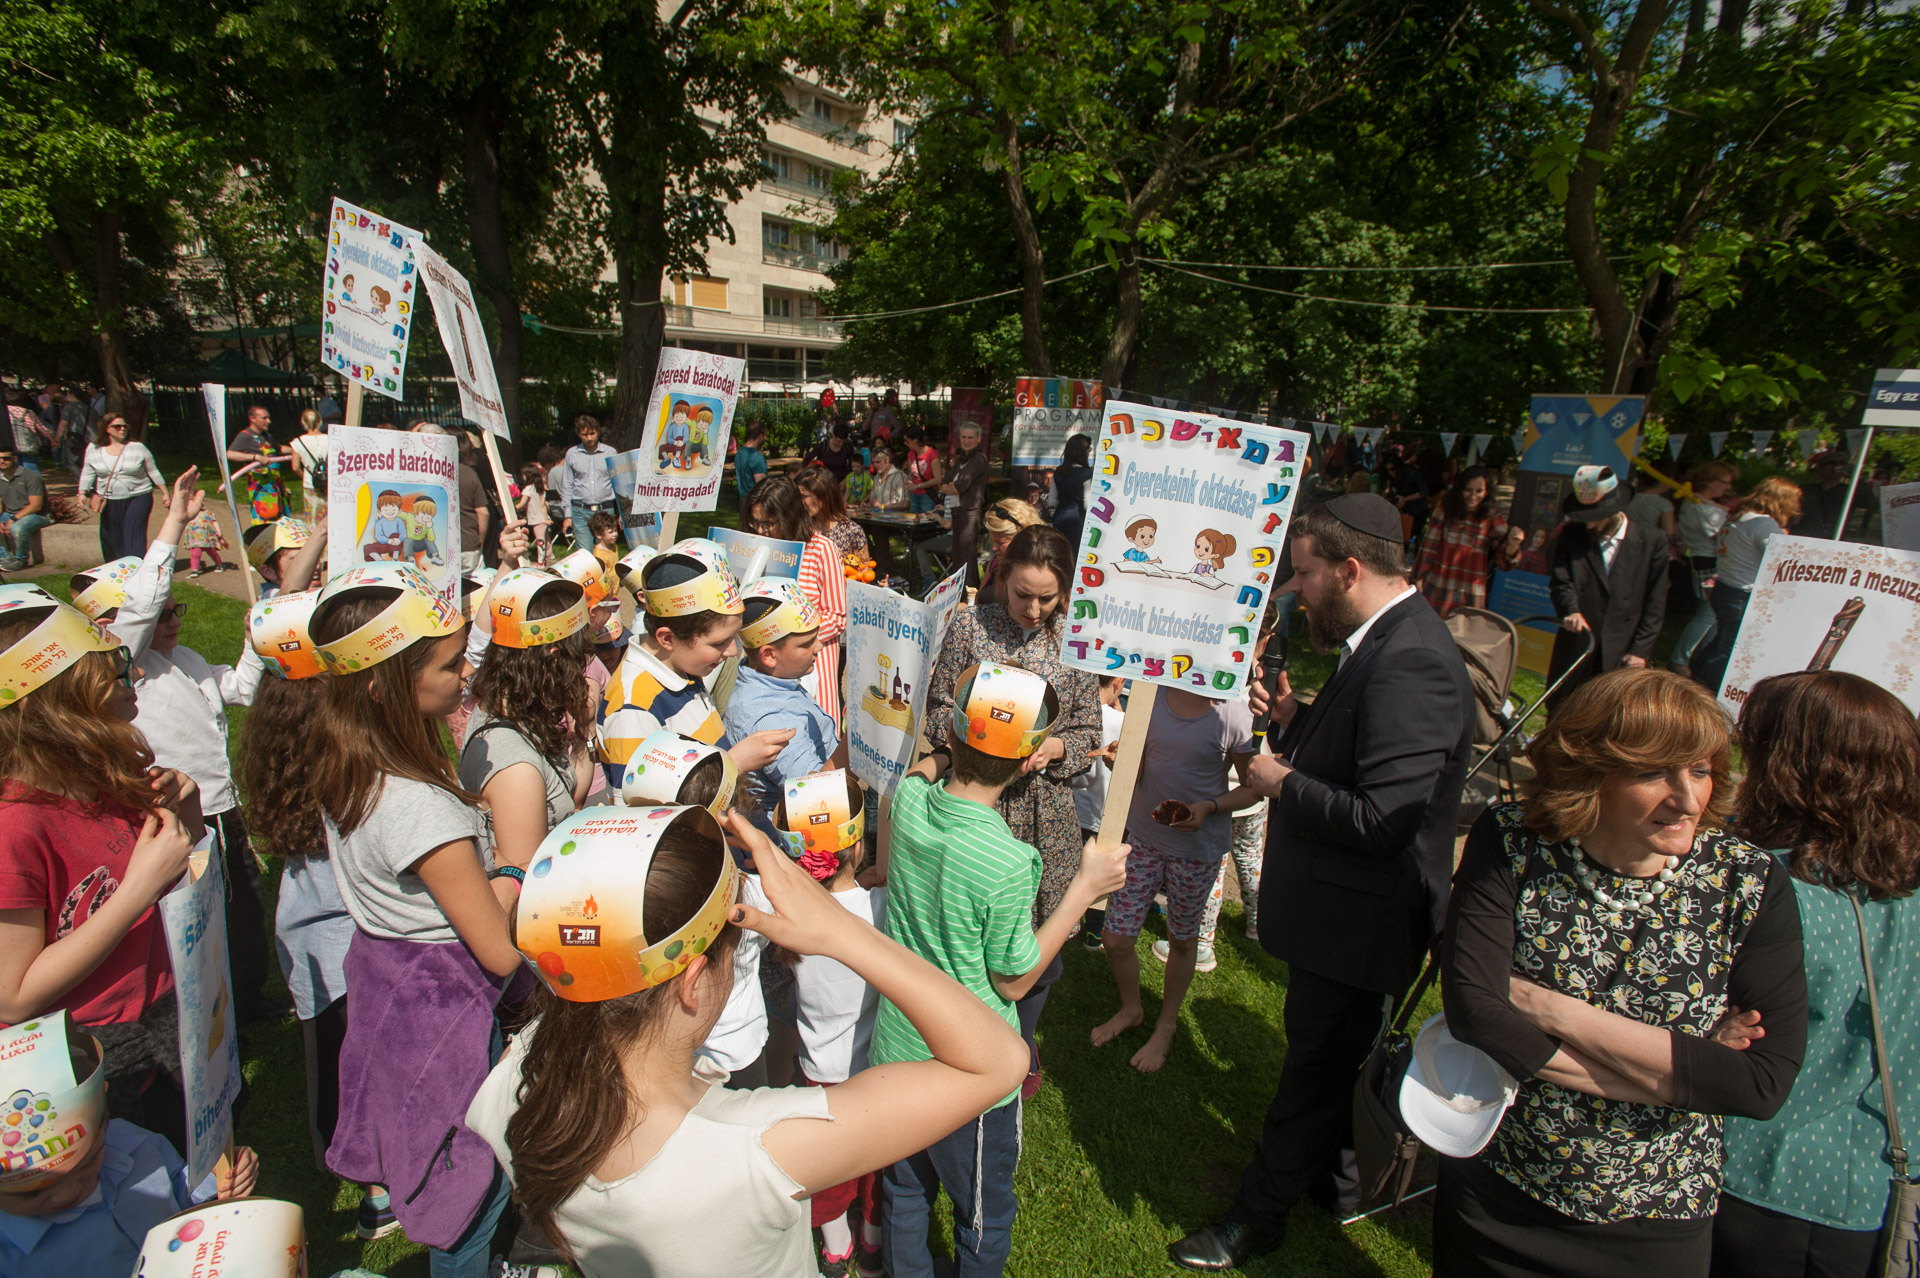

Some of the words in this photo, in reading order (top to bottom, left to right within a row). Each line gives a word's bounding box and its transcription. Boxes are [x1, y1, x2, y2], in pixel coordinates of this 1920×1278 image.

[693, 365, 735, 396] barátodat
[1016, 391, 1099, 408] GYEREK
[1876, 389, 1902, 403] Egy
[1901, 391, 1920, 402] az
[1013, 408, 1100, 422] PROGRAM
[338, 449, 395, 475] Szeresd
[637, 480, 661, 497] mint
[662, 482, 716, 501] magadat!
[1123, 461, 1200, 505] Gyerekeink
[1199, 471, 1257, 520] oktatása
[772, 550, 798, 566] Cháj!
[1773, 560, 1847, 586] Kiteszem
[1849, 568, 1862, 587] a
[852, 603, 886, 630] Sábáti
[1099, 594, 1147, 629] jövőnk
[1149, 602, 1224, 645] biztosítása
[0, 1124, 87, 1175] התהלו
